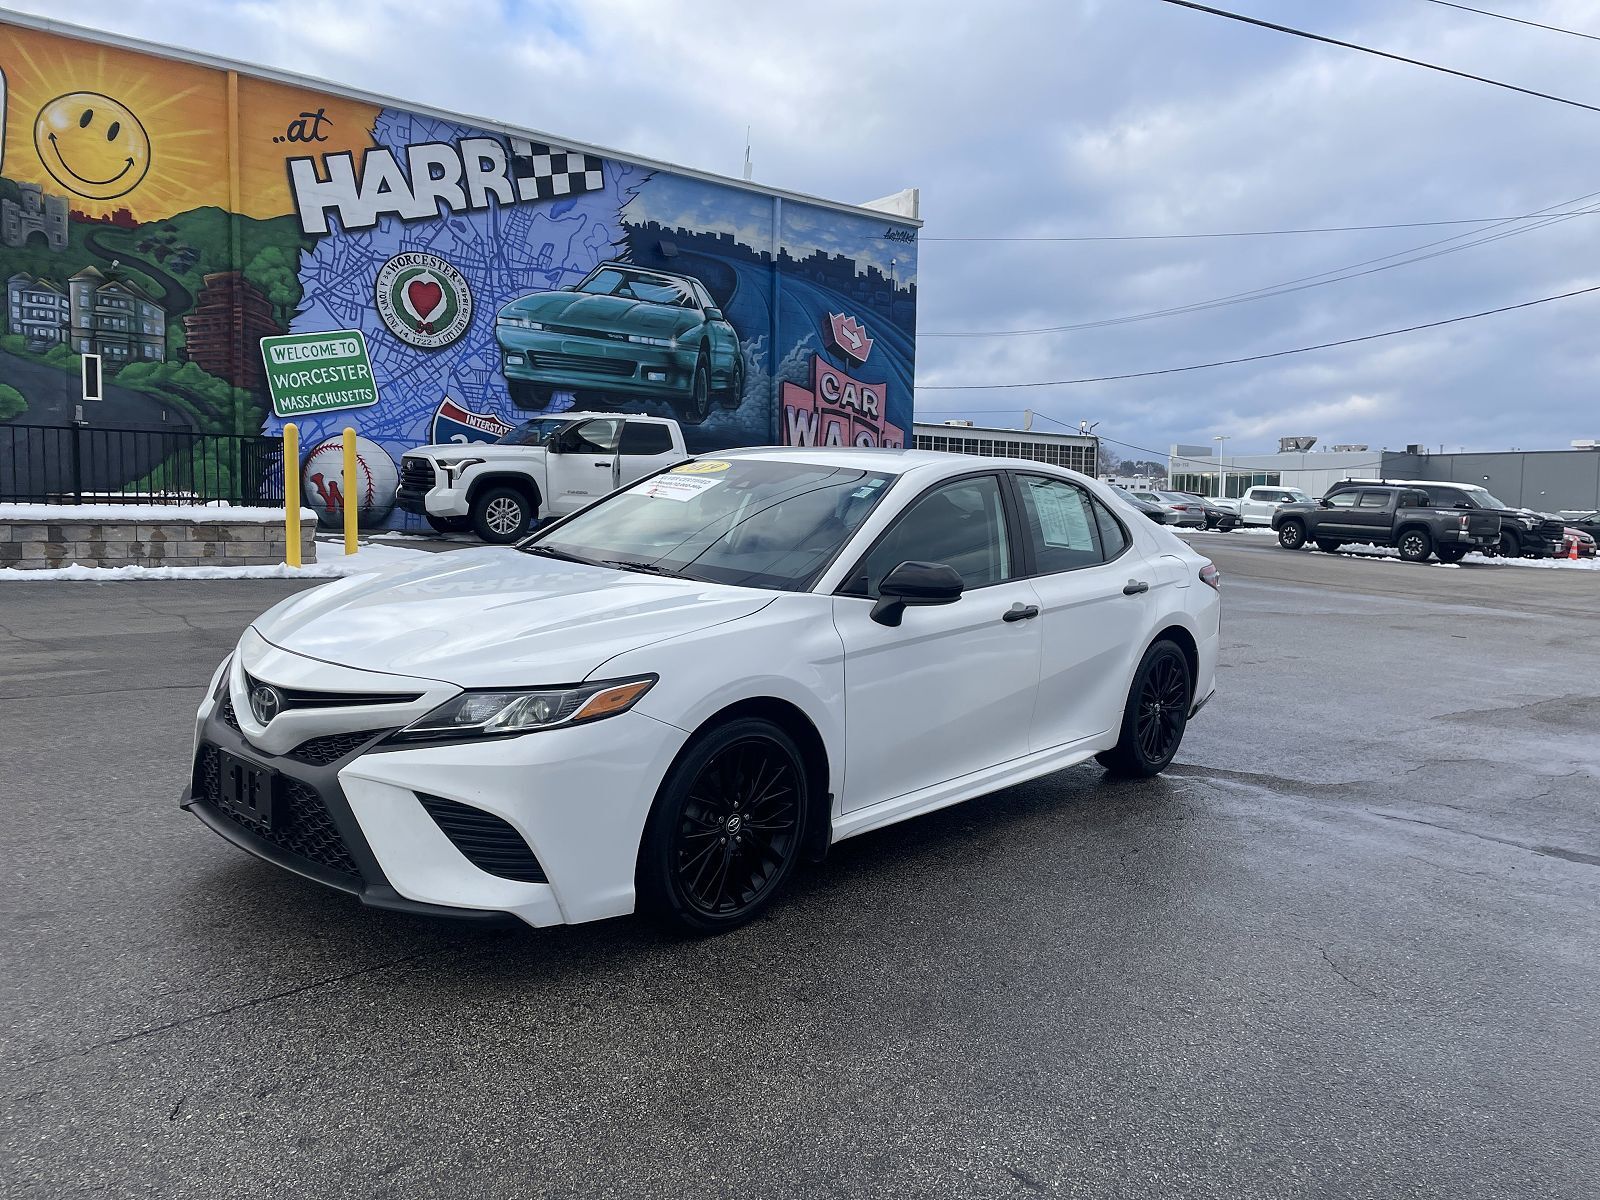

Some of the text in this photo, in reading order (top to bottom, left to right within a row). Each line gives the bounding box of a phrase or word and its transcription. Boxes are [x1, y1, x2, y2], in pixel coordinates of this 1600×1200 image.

[287, 136, 515, 236] HARR
[387, 254, 459, 282] WORCESTER
[379, 290, 389, 311] TOWN
[384, 312, 400, 330] JUNE
[412, 336, 432, 346] 1722
[274, 341, 356, 361] WELCOME TO
[274, 364, 369, 389] WORCESTER
[280, 388, 373, 411] MASSACHUSETTS
[821, 372, 878, 420] CAR
[465, 414, 513, 435] INTERSTAT
